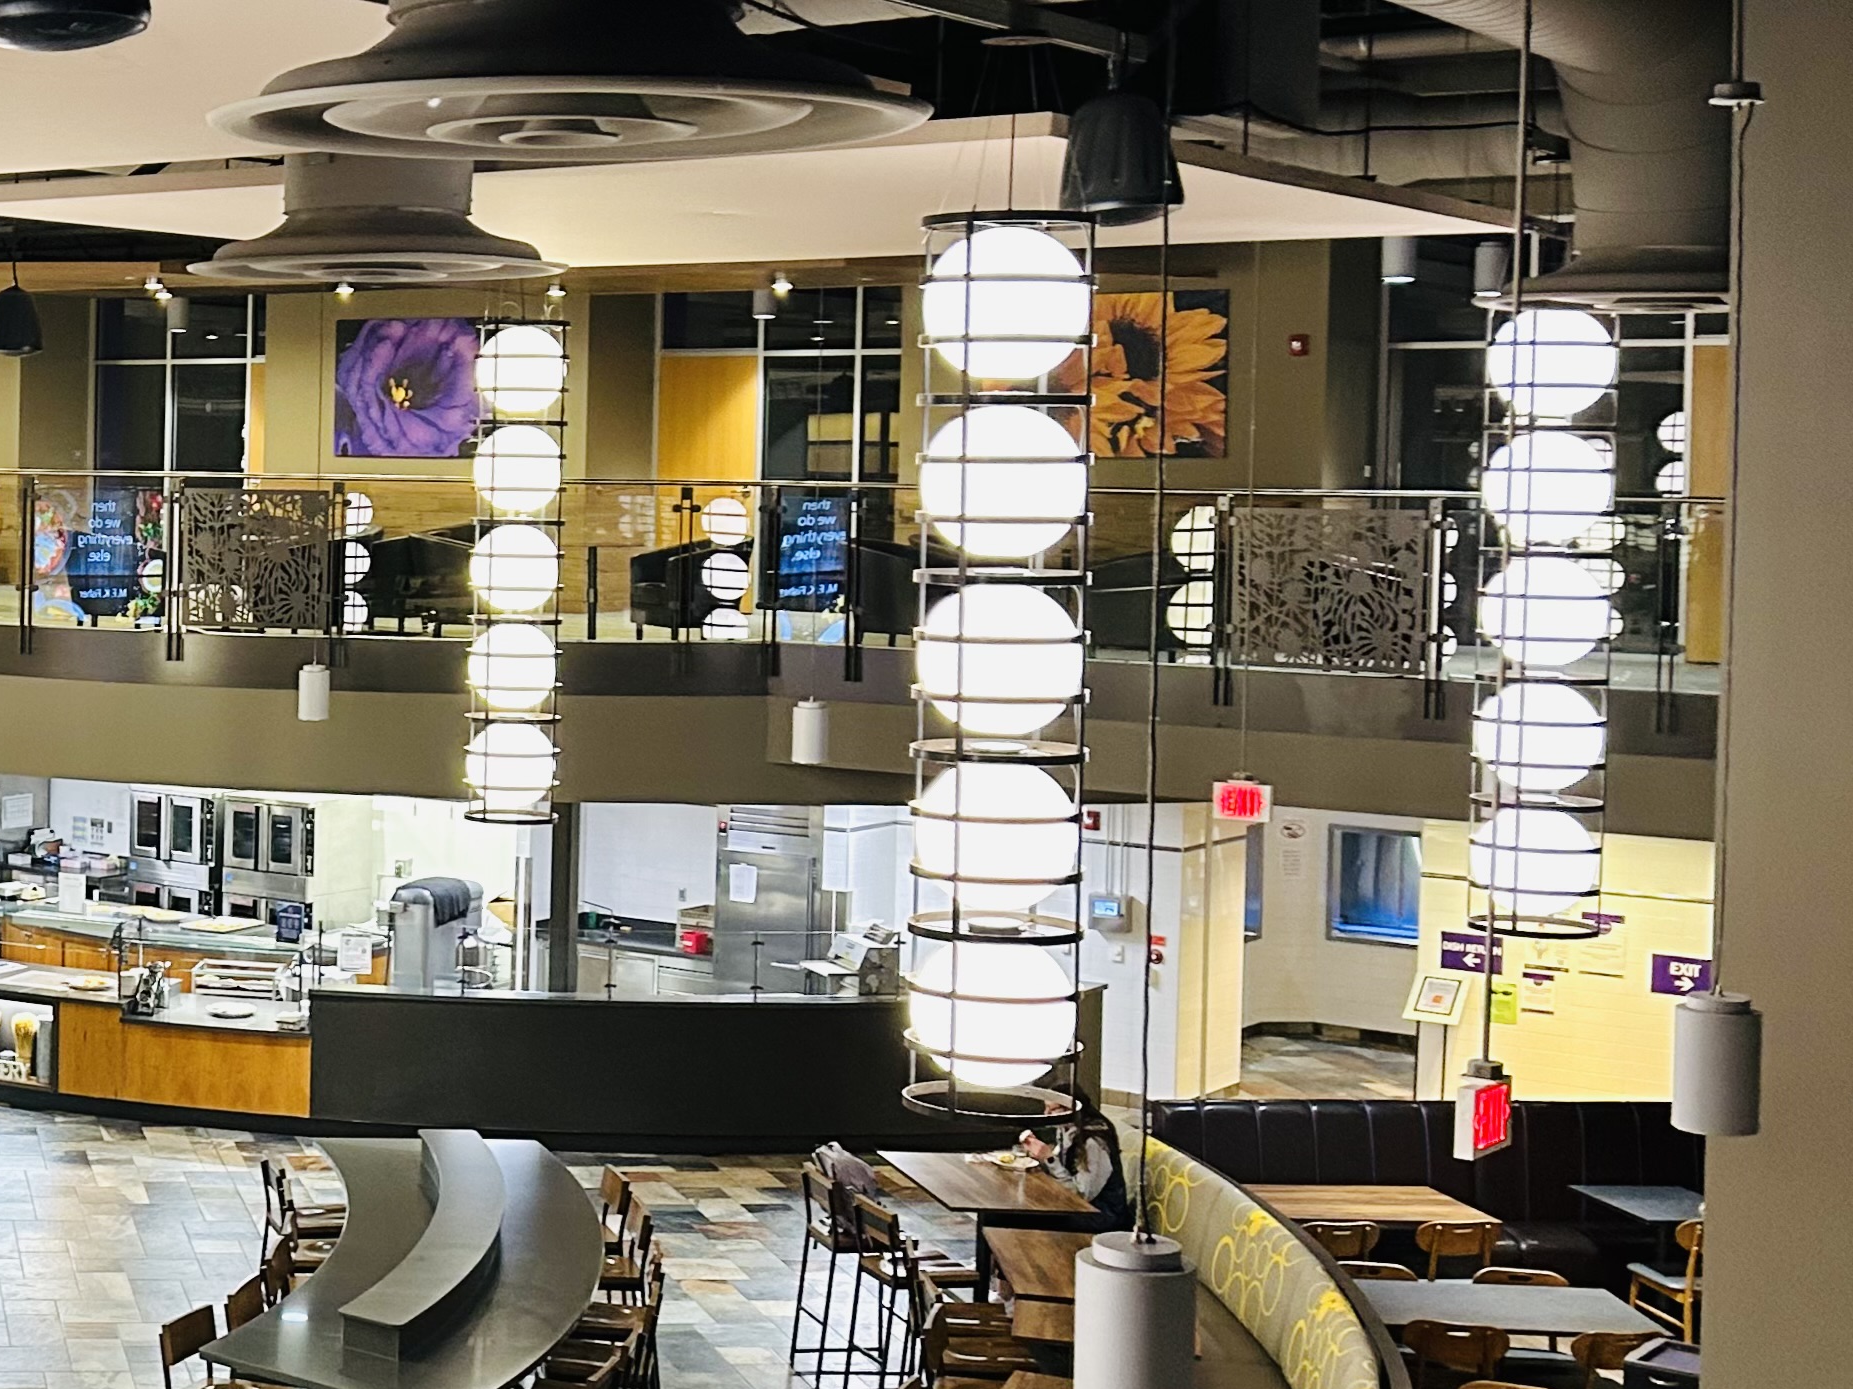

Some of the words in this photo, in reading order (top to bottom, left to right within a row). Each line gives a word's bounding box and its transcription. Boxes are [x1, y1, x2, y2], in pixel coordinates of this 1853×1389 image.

[1221, 786, 1262, 817] EXIT
[1442, 940, 1465, 952] DISH
[1465, 943, 1502, 956] RETUN
[1669, 961, 1702, 978] EXIT
